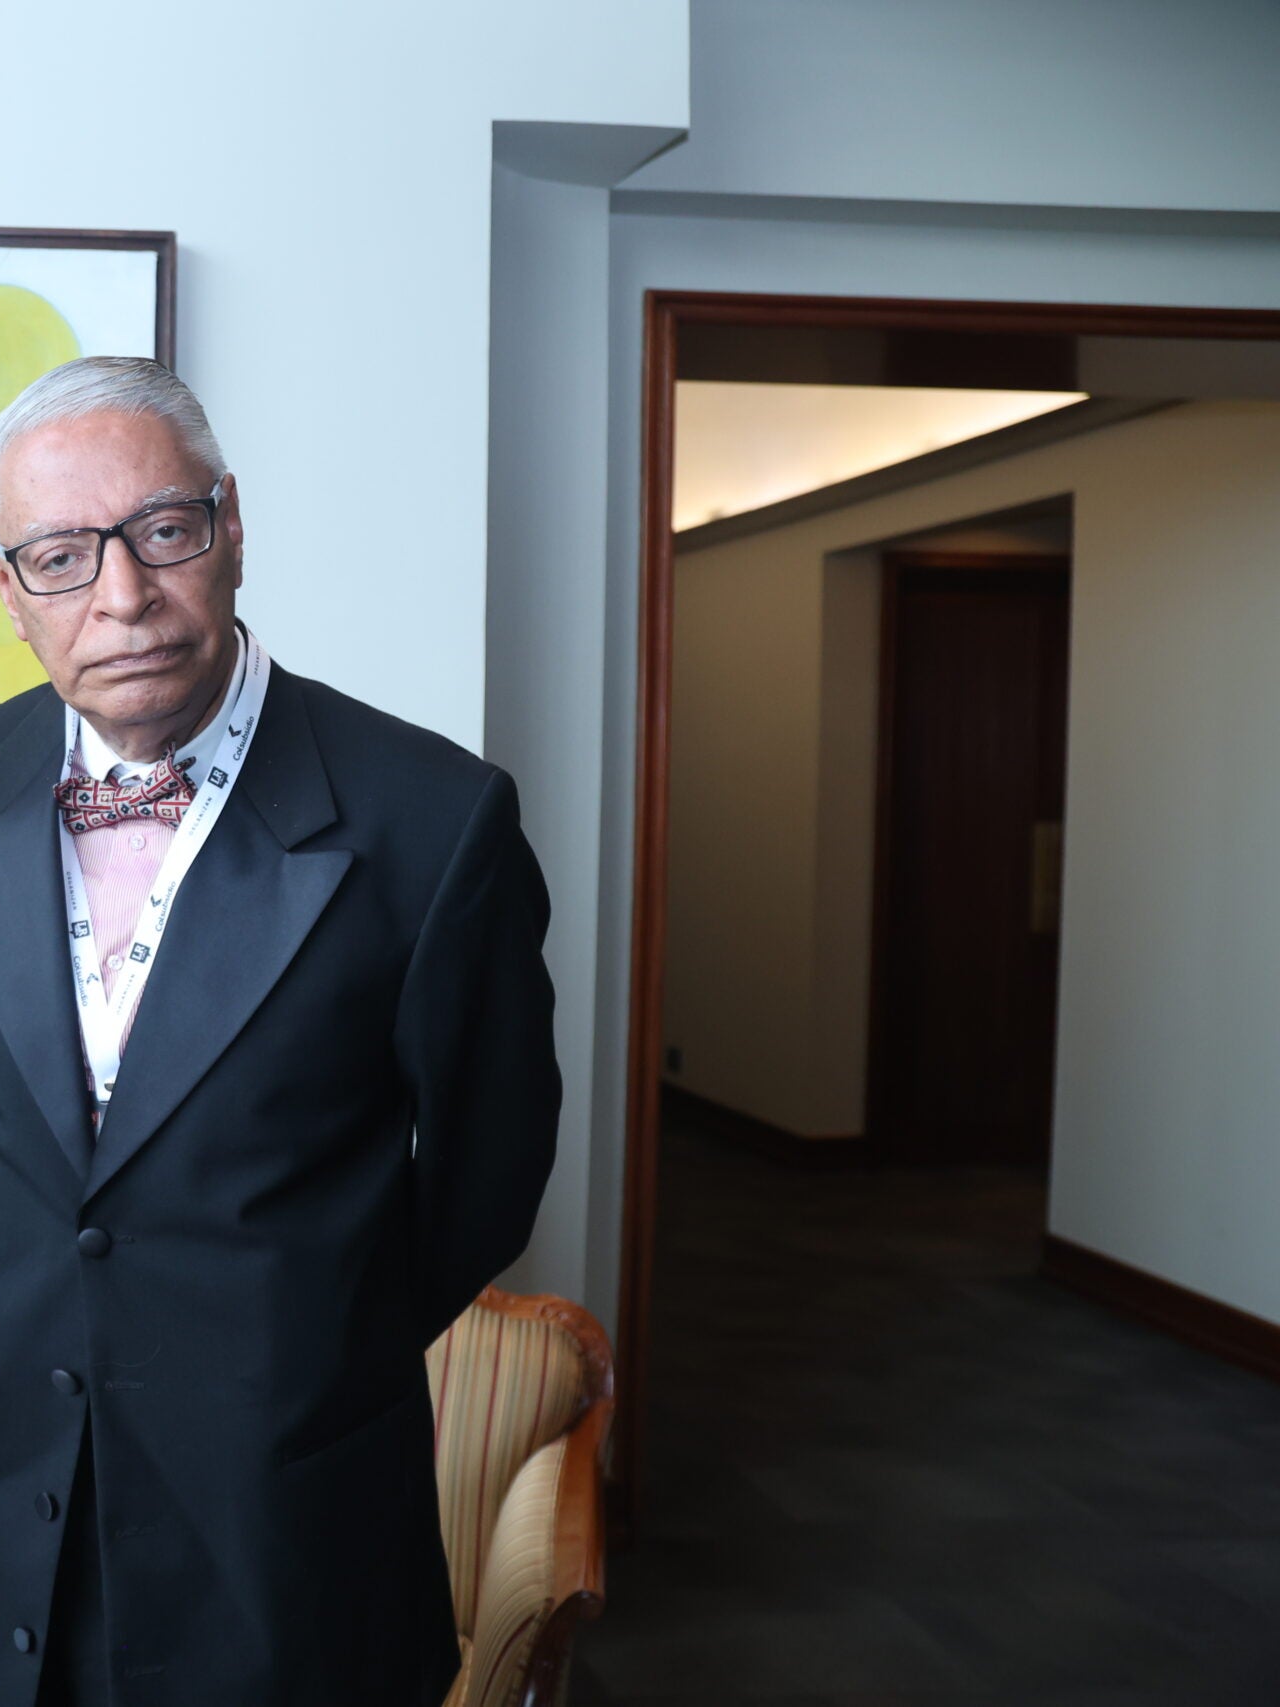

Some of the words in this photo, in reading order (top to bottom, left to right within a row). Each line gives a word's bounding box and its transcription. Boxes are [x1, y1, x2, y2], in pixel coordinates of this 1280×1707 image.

[233, 716, 254, 761] Colsubsidio
[189, 797, 213, 835] ORGANIZAN
[155, 881, 176, 932] Colsubsidio
[73, 955, 88, 1007] Colsubsidio
